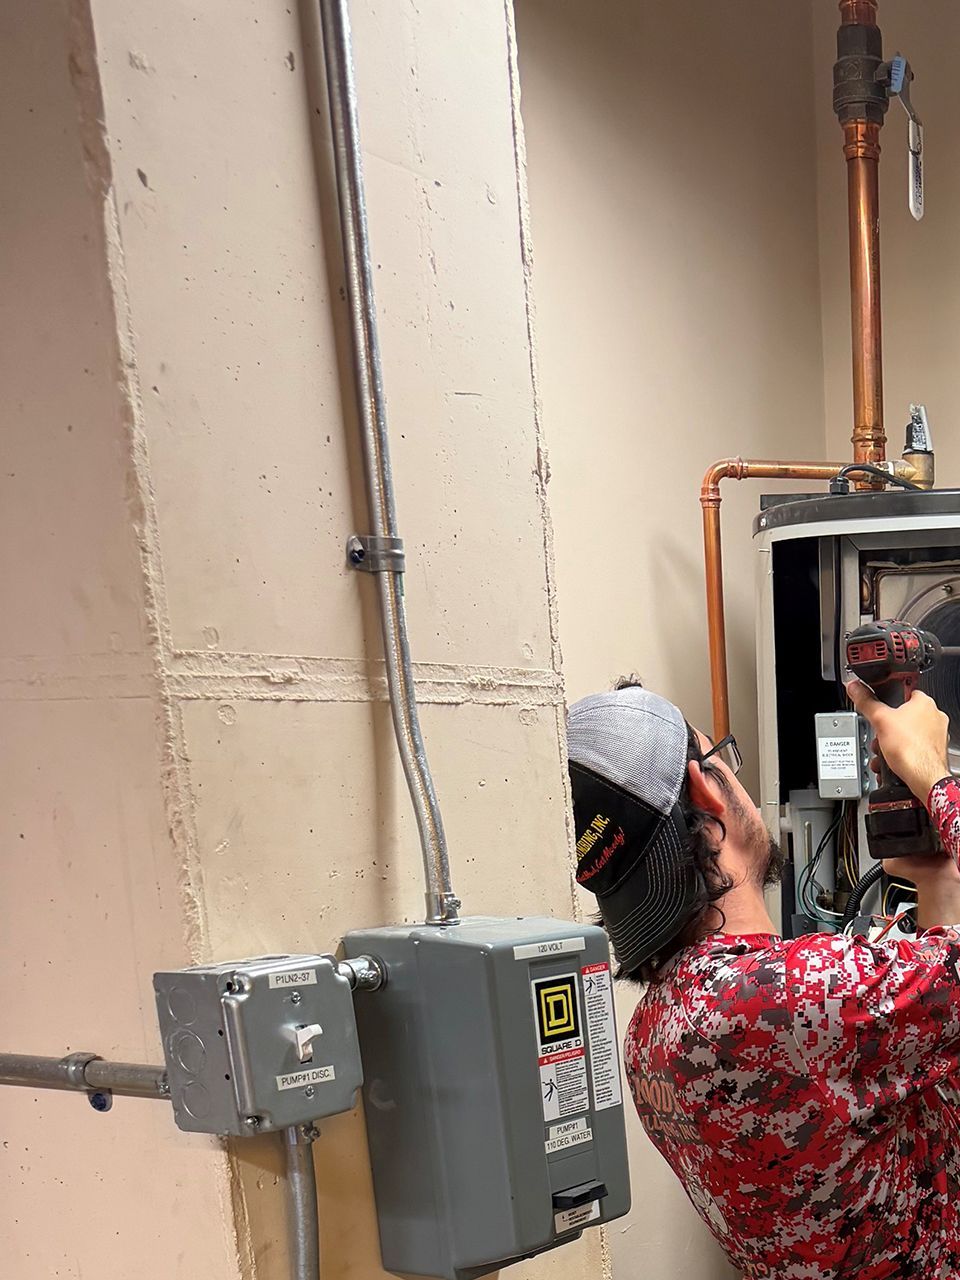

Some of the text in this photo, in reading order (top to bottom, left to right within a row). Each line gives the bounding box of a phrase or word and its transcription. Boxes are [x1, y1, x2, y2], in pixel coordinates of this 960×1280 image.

[538, 942, 563, 953] 120 VOLT
[542, 1039, 582, 1055] SQUARE D
[281, 1074, 310, 1086] PUMP#1
[557, 1122, 579, 1134] PUMP#1
[547, 1140, 557, 1150] 110
[571, 1130, 591, 1142] WATER
